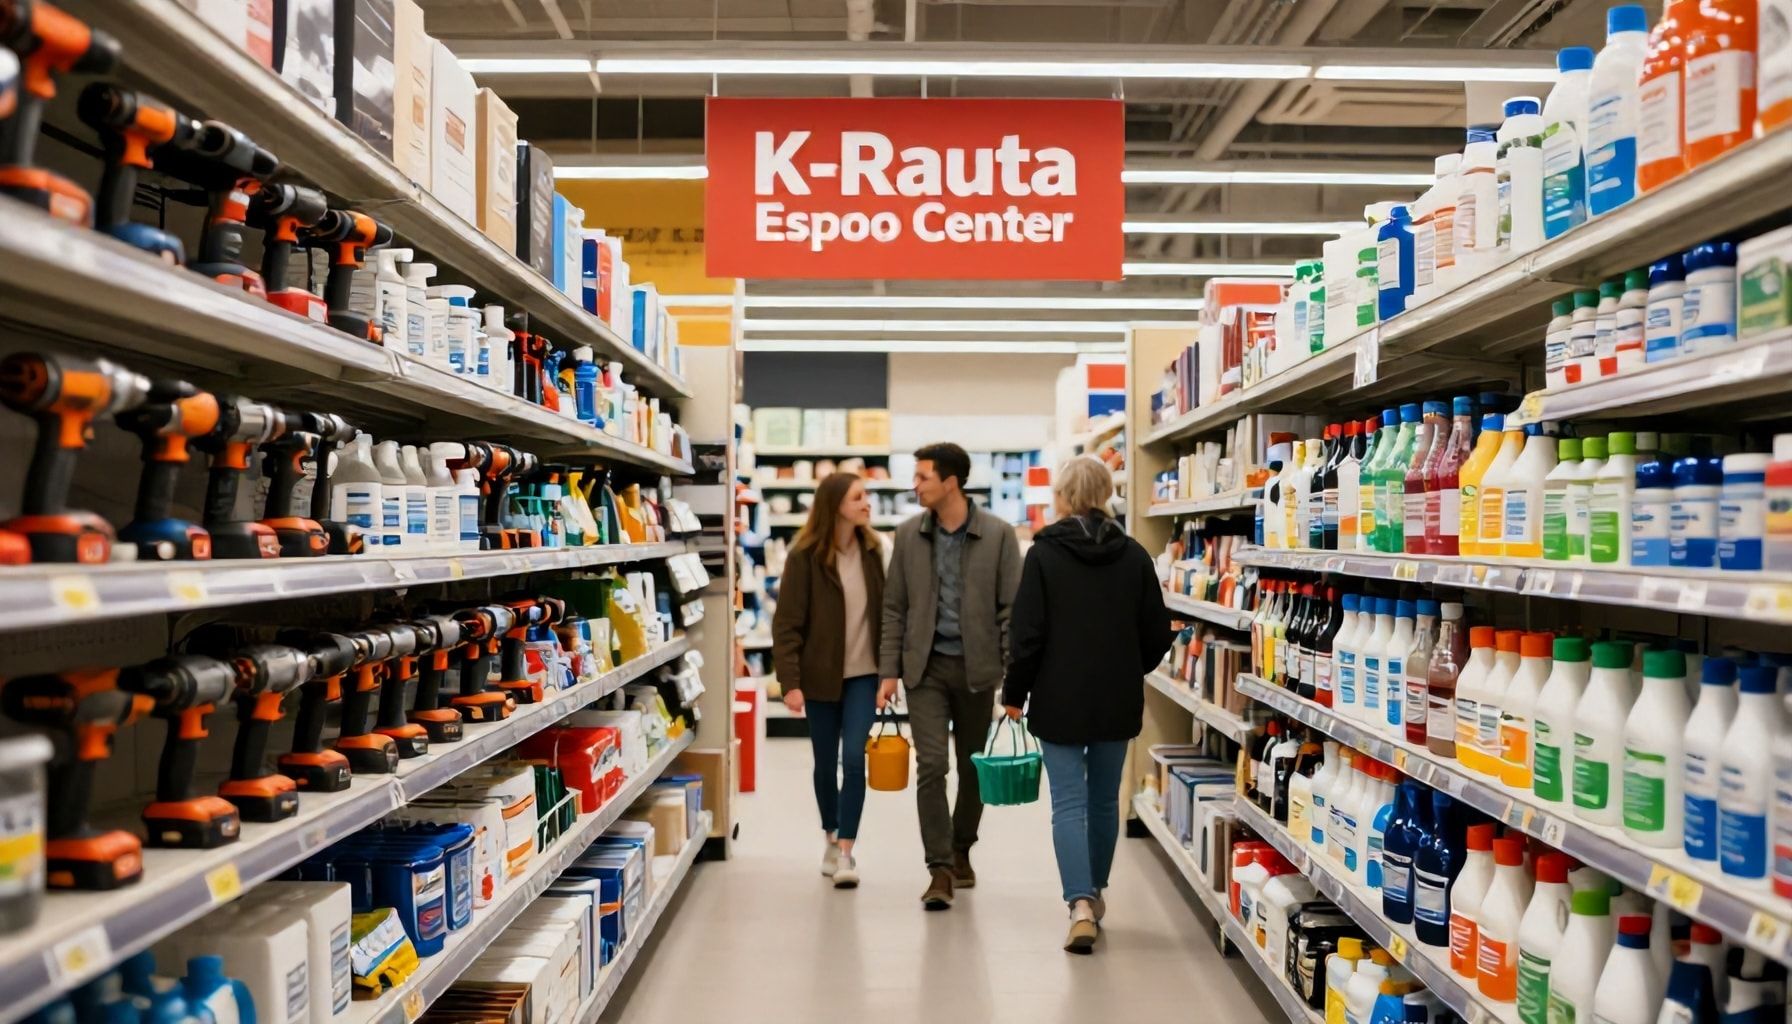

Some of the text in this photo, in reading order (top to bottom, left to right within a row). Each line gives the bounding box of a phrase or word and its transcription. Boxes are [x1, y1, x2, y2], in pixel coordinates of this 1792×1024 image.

[755, 131, 1077, 198] K-Rauta
[756, 202, 1074, 252] Espoo Center
